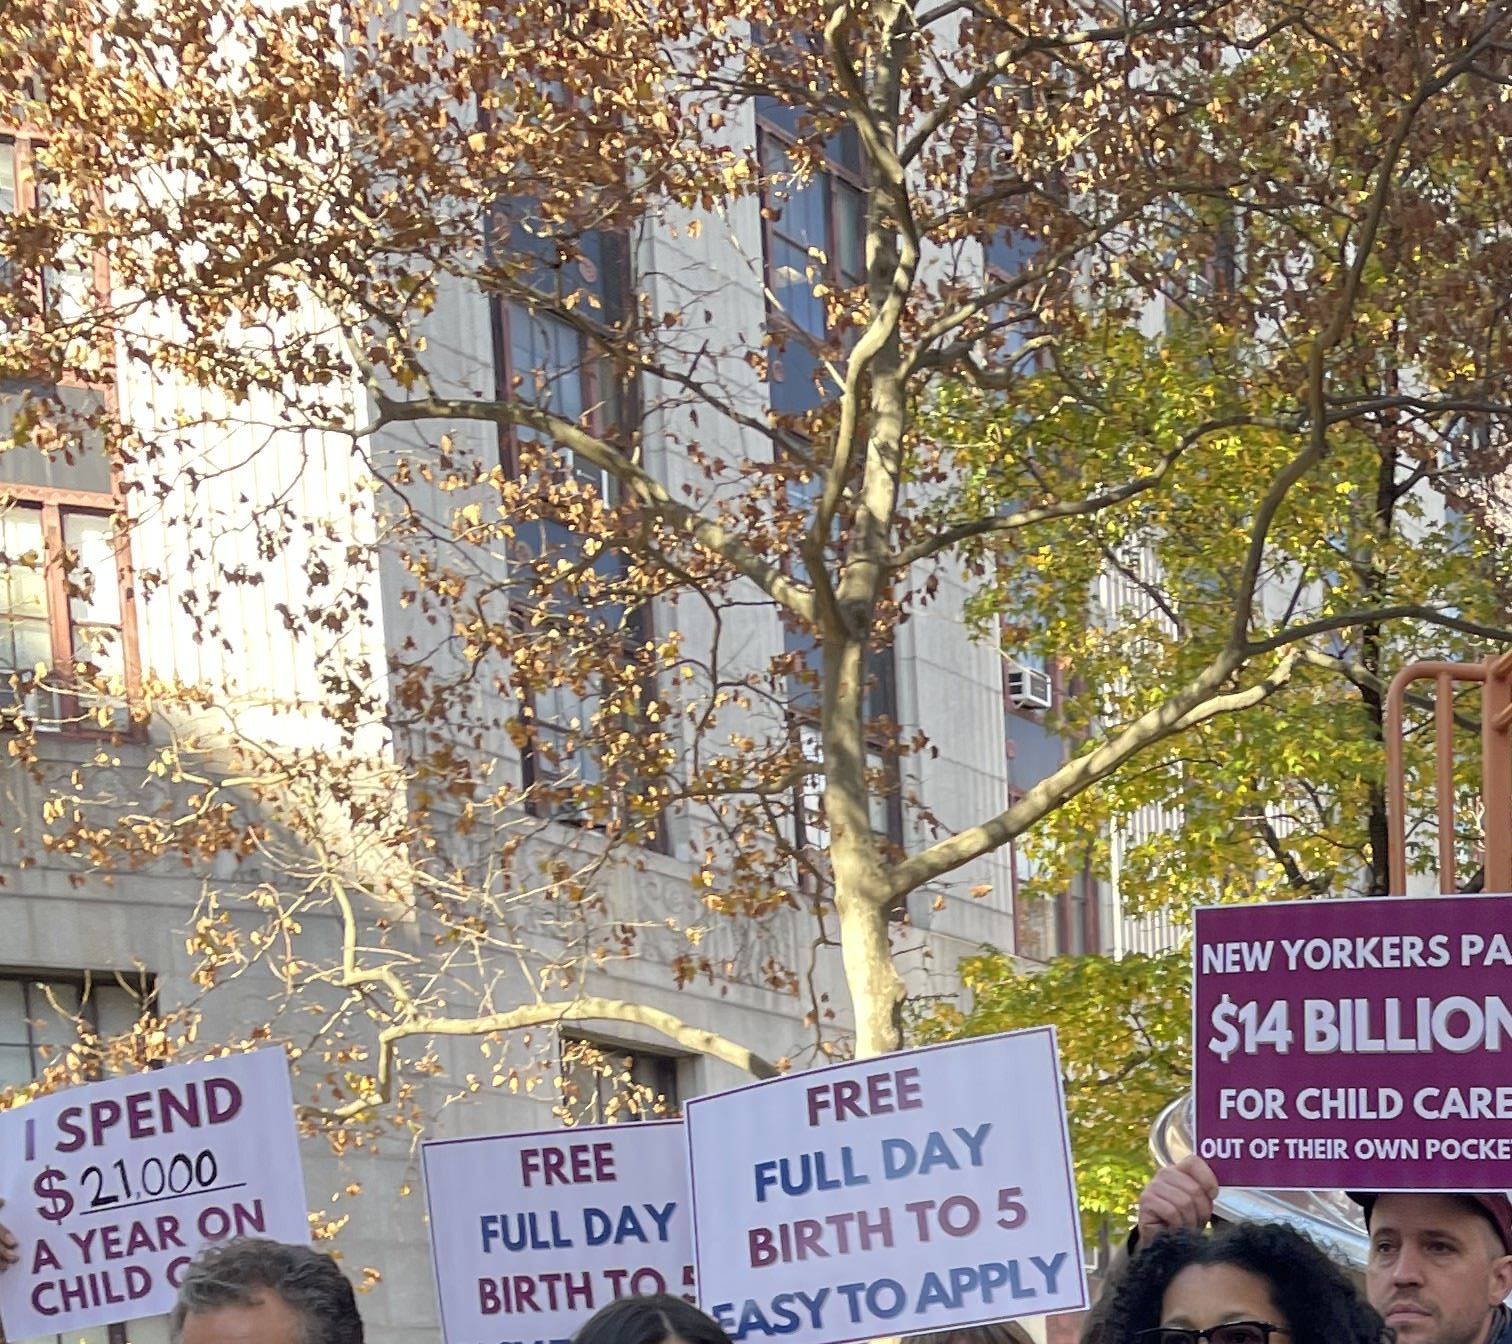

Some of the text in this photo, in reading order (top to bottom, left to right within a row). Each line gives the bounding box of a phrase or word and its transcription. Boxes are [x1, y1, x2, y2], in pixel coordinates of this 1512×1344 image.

[1202, 940, 1274, 974] NEW
[1281, 934, 1451, 971] YORKERS
[1208, 993, 1293, 1063] $14
[24, 1077, 243, 1161] I SPEND
[806, 1066, 923, 1127] FREE
[1220, 1088, 1288, 1120] FOR
[1296, 1087, 1404, 1119] CHILD
[520, 1142, 617, 1187] FREE
[754, 1122, 992, 1203] FULL DAY
[1200, 1138, 1244, 1160] OUT
[1249, 1138, 1280, 1159] OF
[1284, 1138, 1349, 1160] THEIR
[1354, 1138, 1419, 1160] OWN
[31, 1199, 266, 1275] A YEAR ON
[481, 1202, 677, 1253] FULL DAY
[748, 1186, 1027, 1269] BIRTH TO 5
[31, 1265, 152, 1317] CHILD
[478, 1271, 595, 1315] BIRTH
[604, 1267, 666, 1299] TO
[712, 1251, 1068, 1341] EASY TO APPLY
